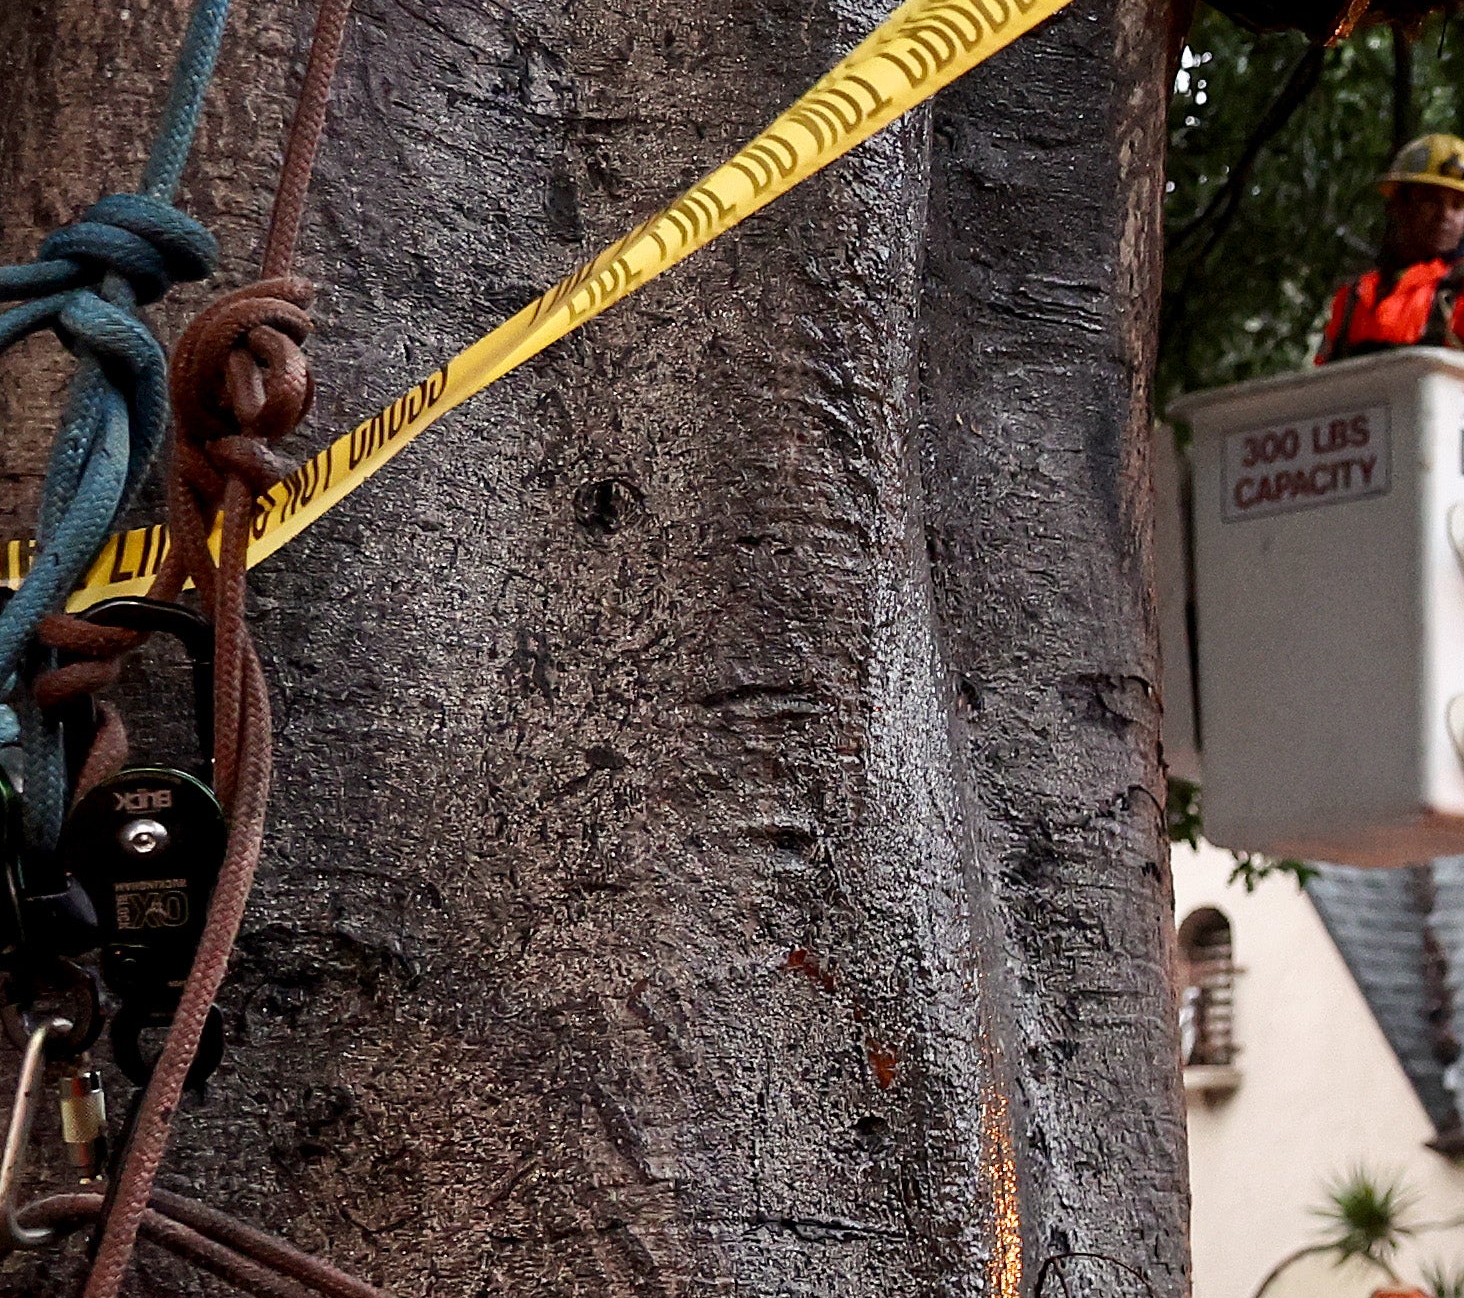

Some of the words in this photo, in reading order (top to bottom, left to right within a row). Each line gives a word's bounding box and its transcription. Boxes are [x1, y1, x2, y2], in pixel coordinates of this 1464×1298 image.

[1242, 428, 1299, 468] 300
[1312, 414, 1371, 455] LBS
[1233, 454, 1378, 511] CAPACITY
